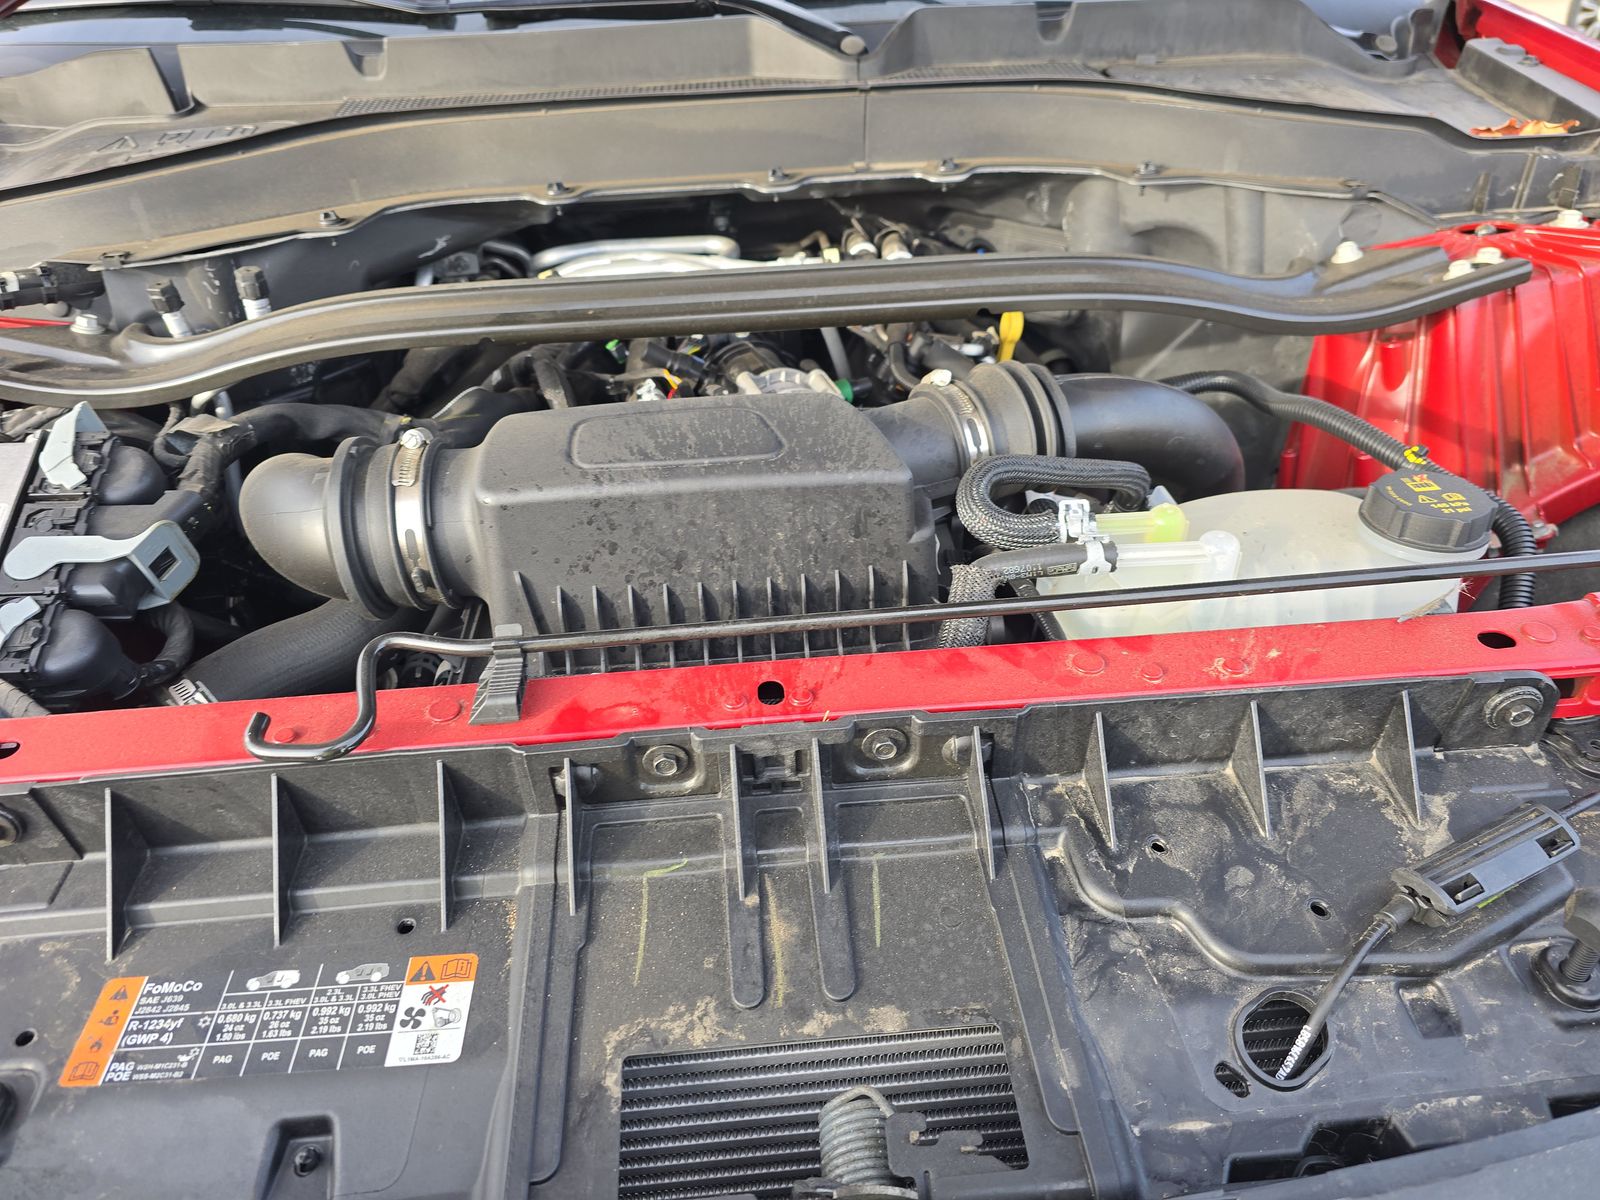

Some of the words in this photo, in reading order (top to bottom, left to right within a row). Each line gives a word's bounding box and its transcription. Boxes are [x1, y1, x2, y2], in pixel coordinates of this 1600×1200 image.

[143, 980, 202, 994] FoMoCo
[378, 991, 400, 999] PHEV
[140, 996, 160, 1004] SAE
[285, 997, 307, 1005] FHEV
[313, 1007, 338, 1017] 0.992
[339, 1006, 351, 1016] kg
[358, 1004, 383, 1014] 0.992
[384, 1003, 396, 1013] kg
[244, 1012, 257, 1023] kg
[263, 1010, 289, 1021] 0.737
[290, 1010, 302, 1020] kg
[364, 1014, 374, 1022] 35
[128, 1018, 185, 1031] R-1234yf
[319, 1017, 329, 1025] 35
[223, 1024, 233, 1032] 24
[311, 1026, 328, 1034] 2.19
[357, 1023, 374, 1031] 2.19
[375, 1022, 388, 1030] lbs
[233, 1032, 246, 1040] lbs
[279, 1029, 292, 1037] lbs
[121, 1033, 159, 1047] (GWP
[160, 1032, 173, 1044] 4)
[309, 1048, 328, 1058] PAG
[357, 1045, 376, 1054] POE
[213, 1055, 233, 1064] PAG
[261, 1052, 280, 1061] POE
[110, 1061, 135, 1071] PAG
[105, 1071, 132, 1082] POE
